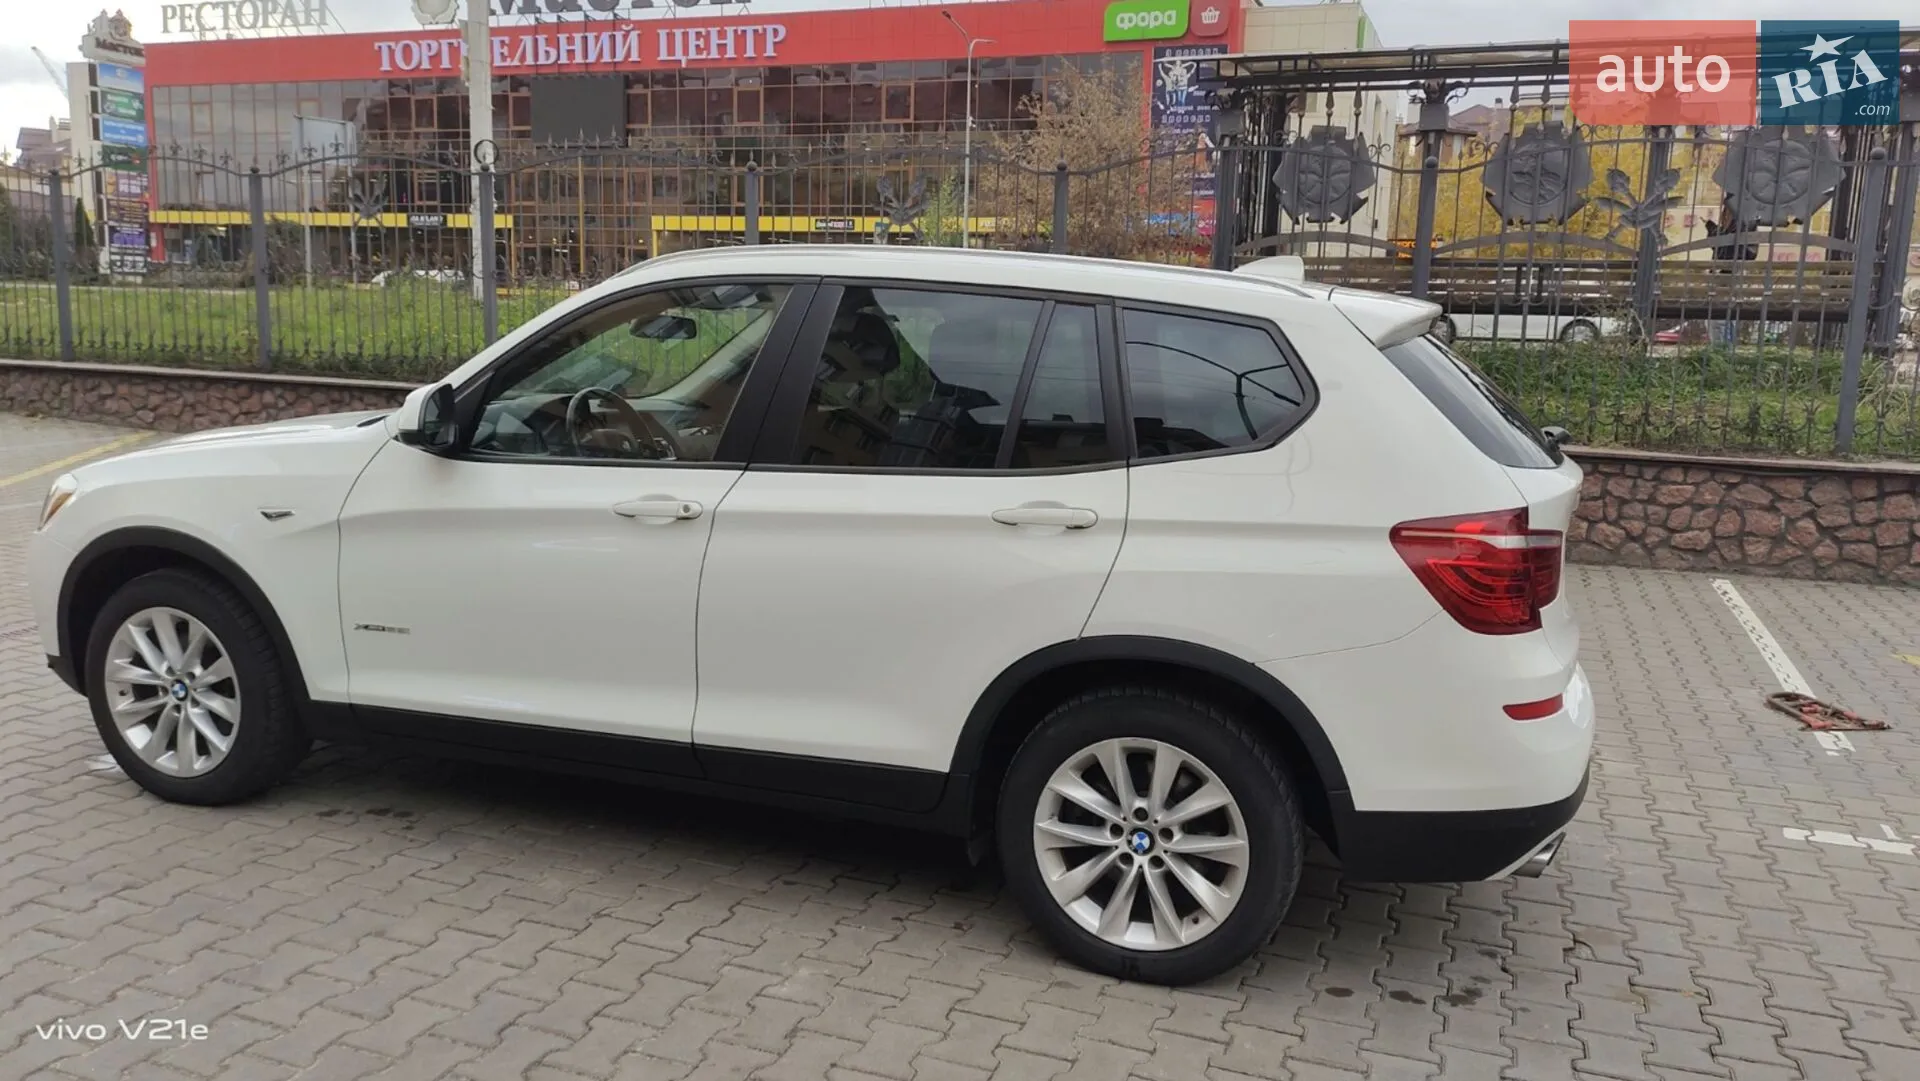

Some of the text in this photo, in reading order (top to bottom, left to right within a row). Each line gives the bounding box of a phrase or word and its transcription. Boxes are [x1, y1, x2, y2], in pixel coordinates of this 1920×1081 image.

[160, 0, 328, 33] РЕСТОРАН
[374, 24, 787, 71] ТОРГЕЛЬНИЙ ЦЕНТР
